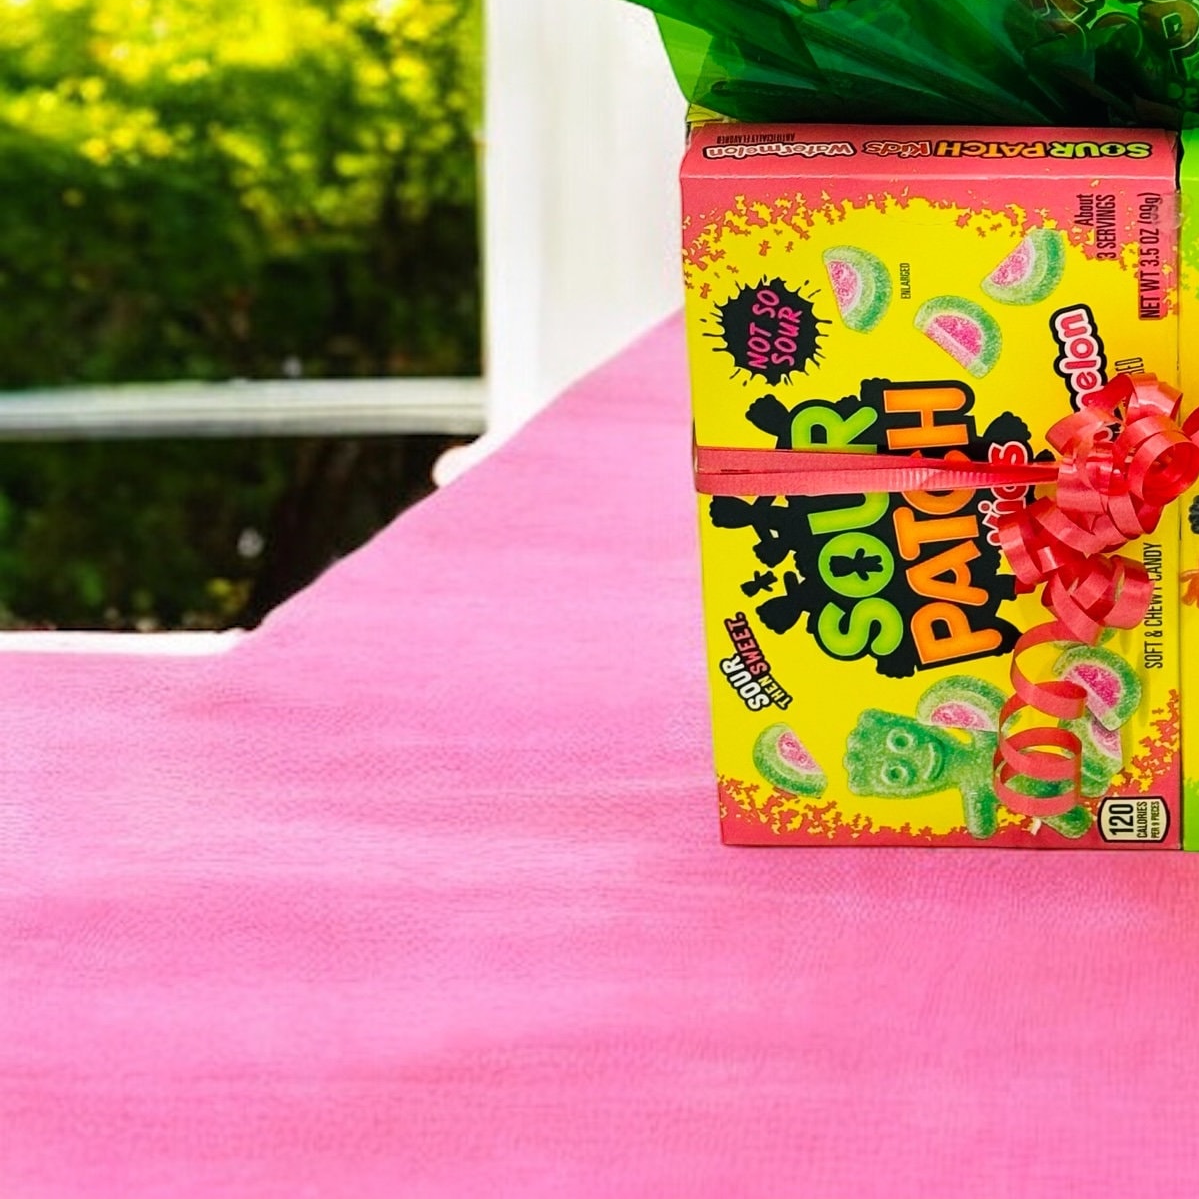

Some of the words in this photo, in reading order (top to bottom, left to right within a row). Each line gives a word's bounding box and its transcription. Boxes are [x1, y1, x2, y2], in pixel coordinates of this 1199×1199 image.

[704, 141, 853, 159] Watermelon
[865, 140, 930, 158] Kids
[936, 141, 1047, 159] PATCH
[1047, 141, 1153, 159] SOUR
[1075, 194, 1094, 226] About
[1096, 194, 1117, 249] SERVINGS
[1140, 228, 1160, 244] OZ
[1097, 250, 1117, 259] 3
[1140, 248, 1160, 267] 3.5
[900, 263, 911, 300] ENLARGED
[1140, 271, 1160, 292] WT
[752, 289, 780, 318] SO
[1140, 295, 1160, 318] NET
[748, 322, 772, 369] NOT
[771, 306, 803, 367] SOUR
[791, 406, 903, 656] SOUR
[884, 387, 1003, 665] PATCH
[1143, 542, 1162, 582] CANDY
[1144, 587, 1162, 626] CHEW
[1144, 630, 1163, 638] &
[1144, 641, 1163, 669] SOFT
[722, 655, 770, 710] SOUR
[758, 675, 791, 709] THEN
[1108, 803, 1134, 836] 120
[1136, 801, 1148, 838] CALORIES
[1150, 801, 1160, 821] PIECES
[1150, 827, 1160, 838] PER
